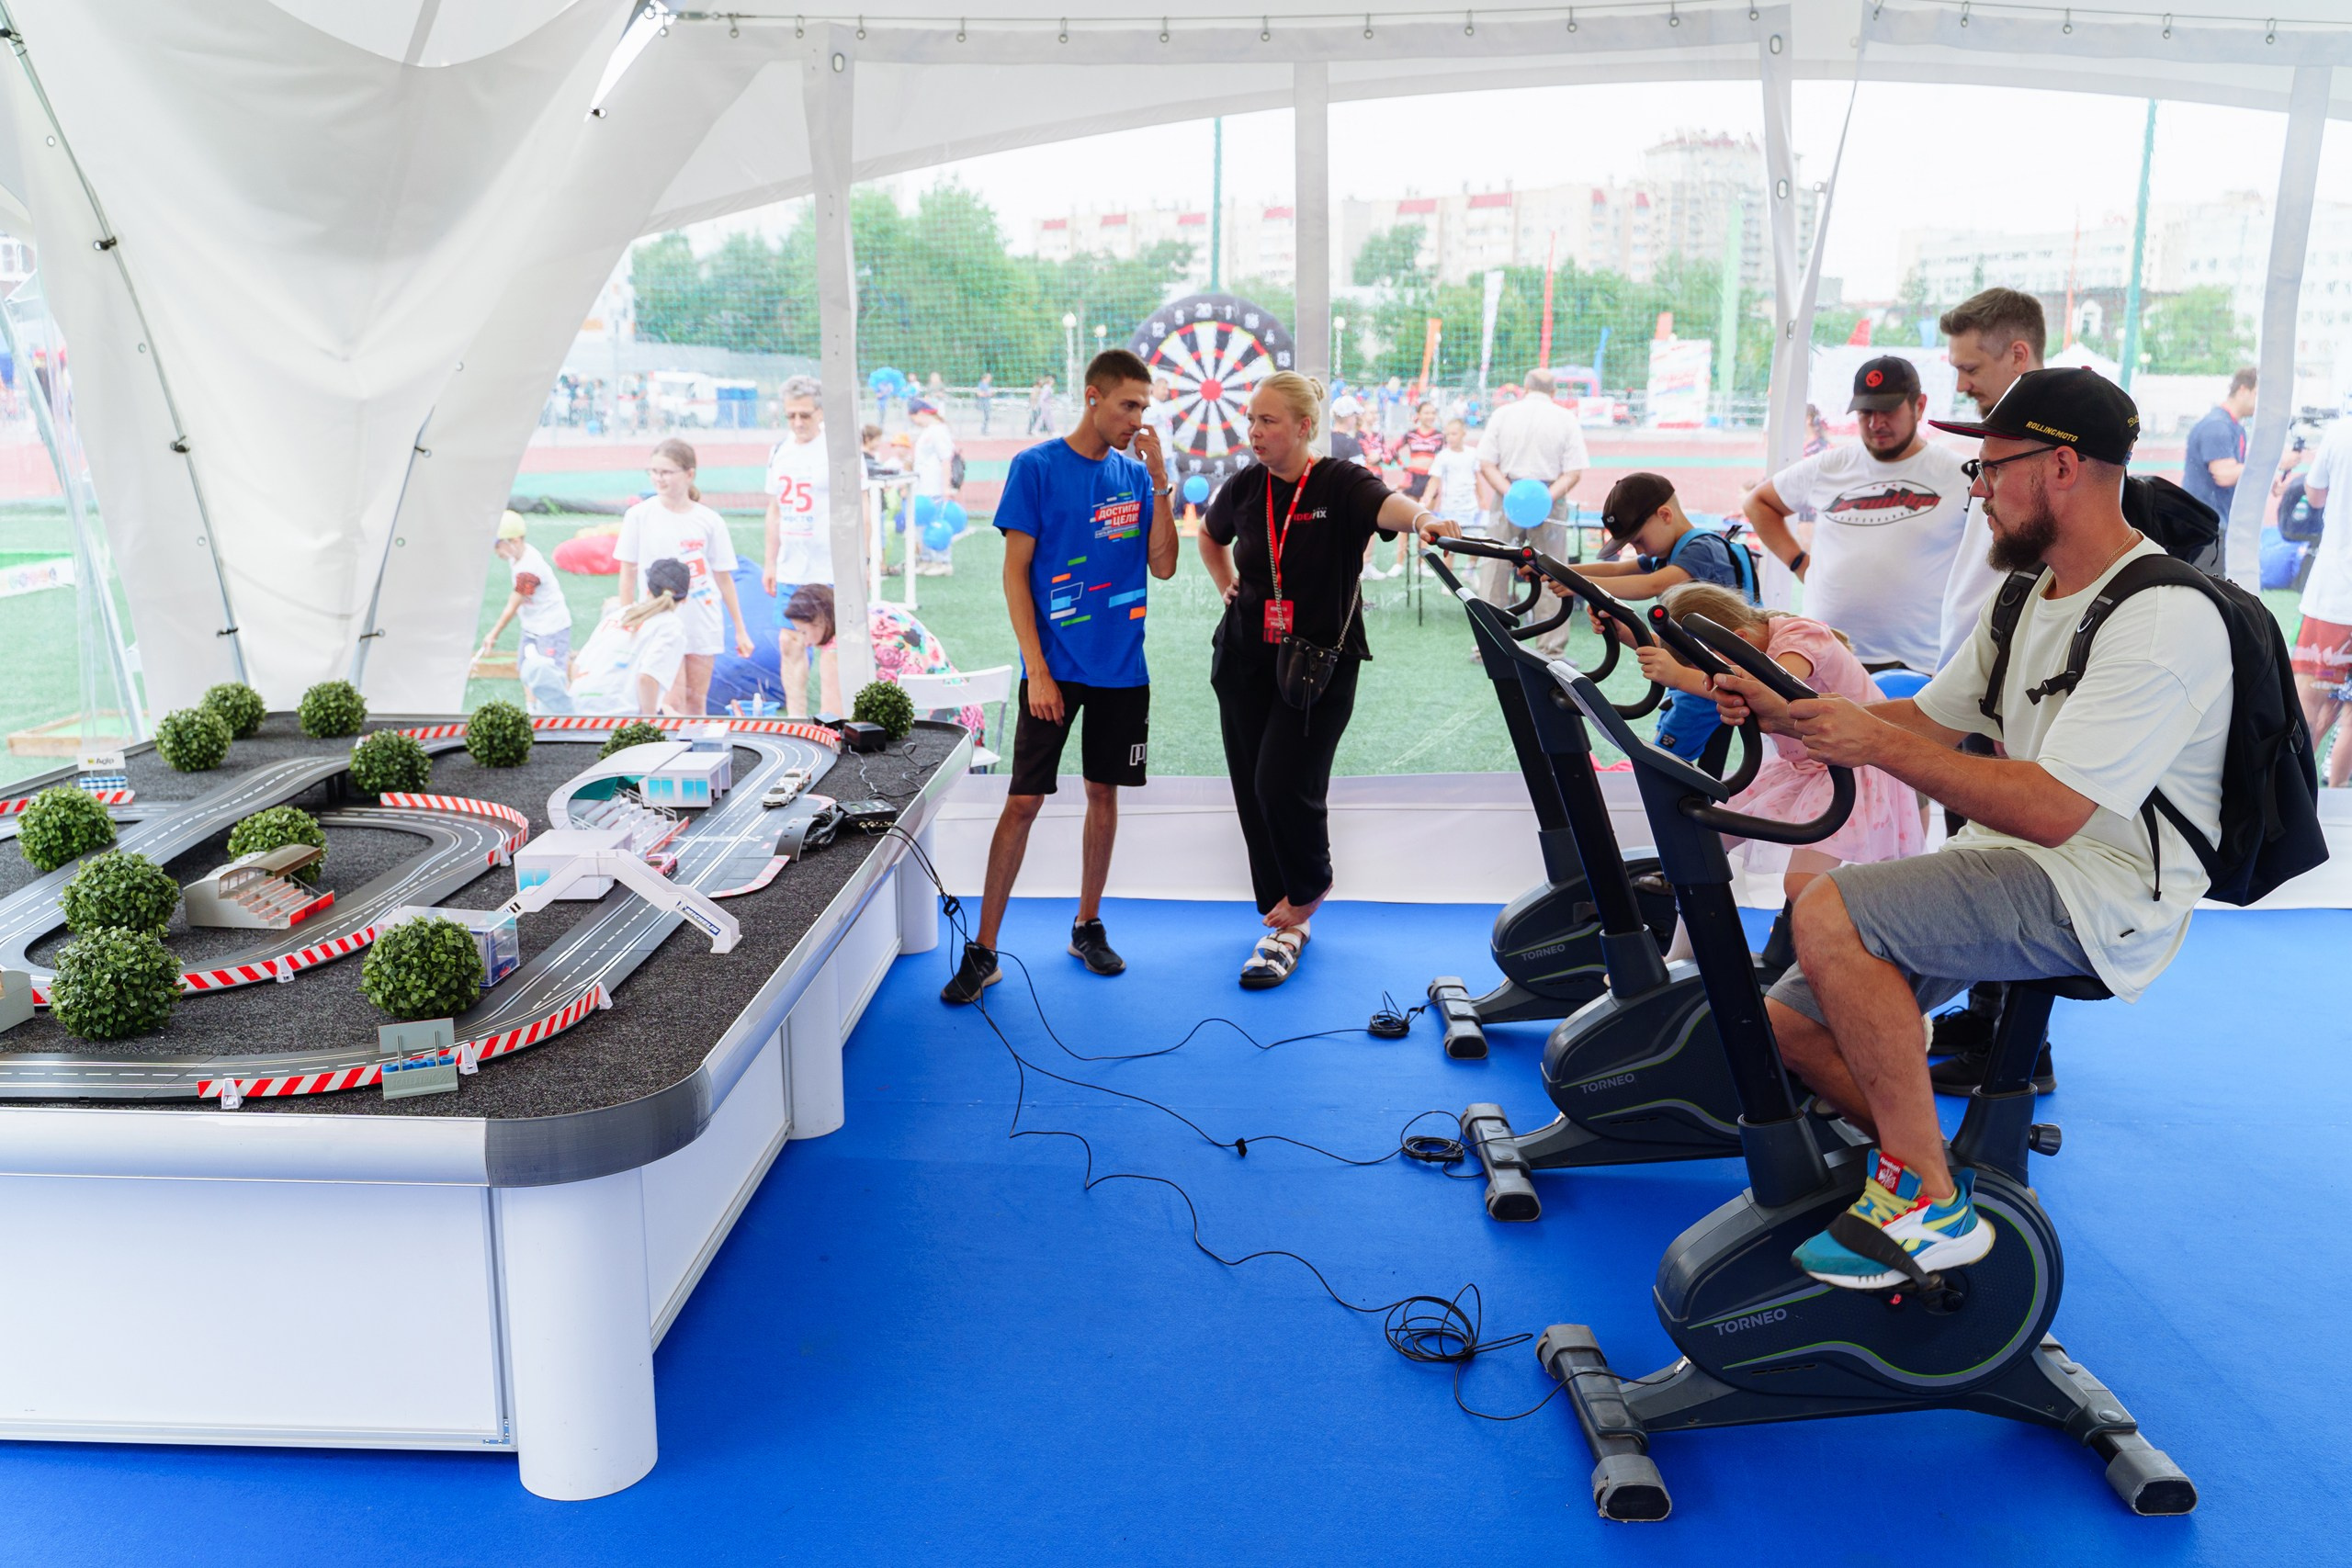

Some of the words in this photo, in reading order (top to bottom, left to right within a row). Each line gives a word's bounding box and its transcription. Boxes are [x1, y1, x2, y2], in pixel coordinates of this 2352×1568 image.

[778, 475, 813, 513] 25
[1521, 943, 1566, 962] TORNEO
[1580, 1073, 1634, 1094] TORNEO
[1713, 1308, 1787, 1336] TORNEO
